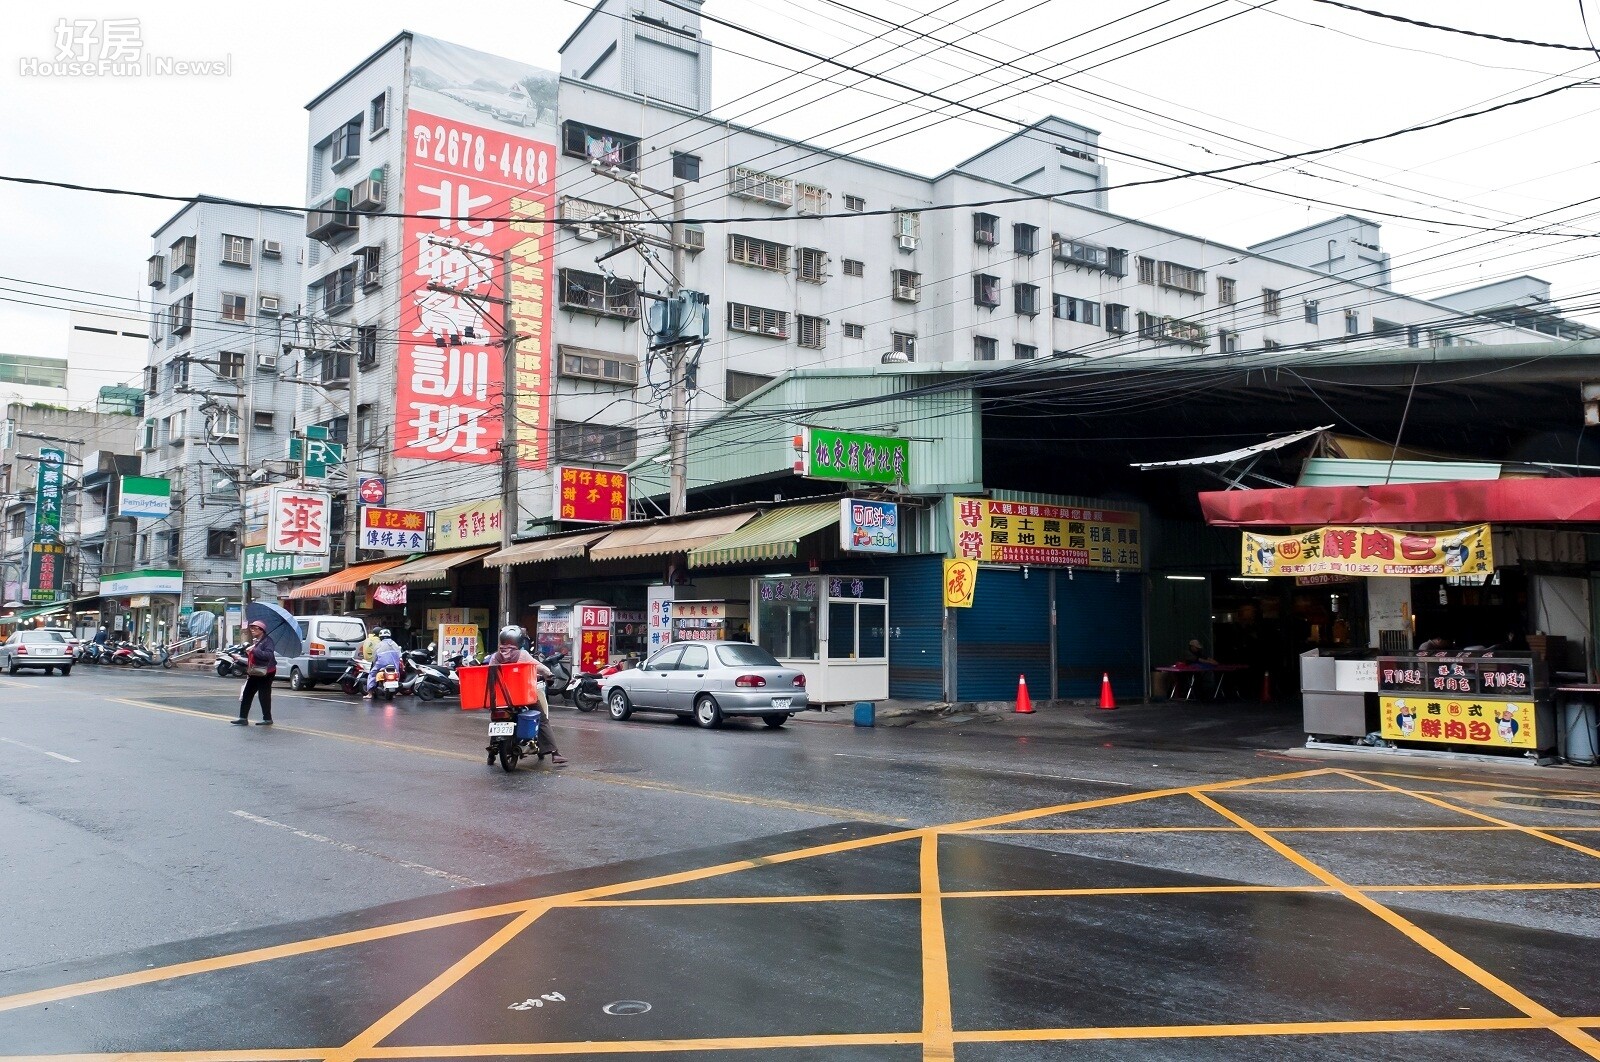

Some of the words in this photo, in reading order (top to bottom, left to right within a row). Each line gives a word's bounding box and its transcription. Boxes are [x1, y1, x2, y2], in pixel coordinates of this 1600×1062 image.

[434, 125, 548, 186] 2678-4488
[406, 180, 496, 456] 北聯駕訓班
[563, 468, 624, 489] 蚵仔麵線
[123, 498, 168, 509] FamilyMart
[368, 510, 399, 528] 曹記
[852, 504, 884, 529] 西瓜汁
[366, 530, 423, 549] 傳統美食
[959, 500, 984, 559] 專營
[1323, 529, 1437, 560] 鮮肉包
[1394, 564, 1444, 574] 0970-135-965
[583, 609, 608, 625] 肉圓
[662, 600, 671, 627] 台中
[1384, 669, 1421, 684] 買10送2
[1483, 671, 1526, 688] 買10送2
[1421, 718, 1492, 742] 鮮肉包
